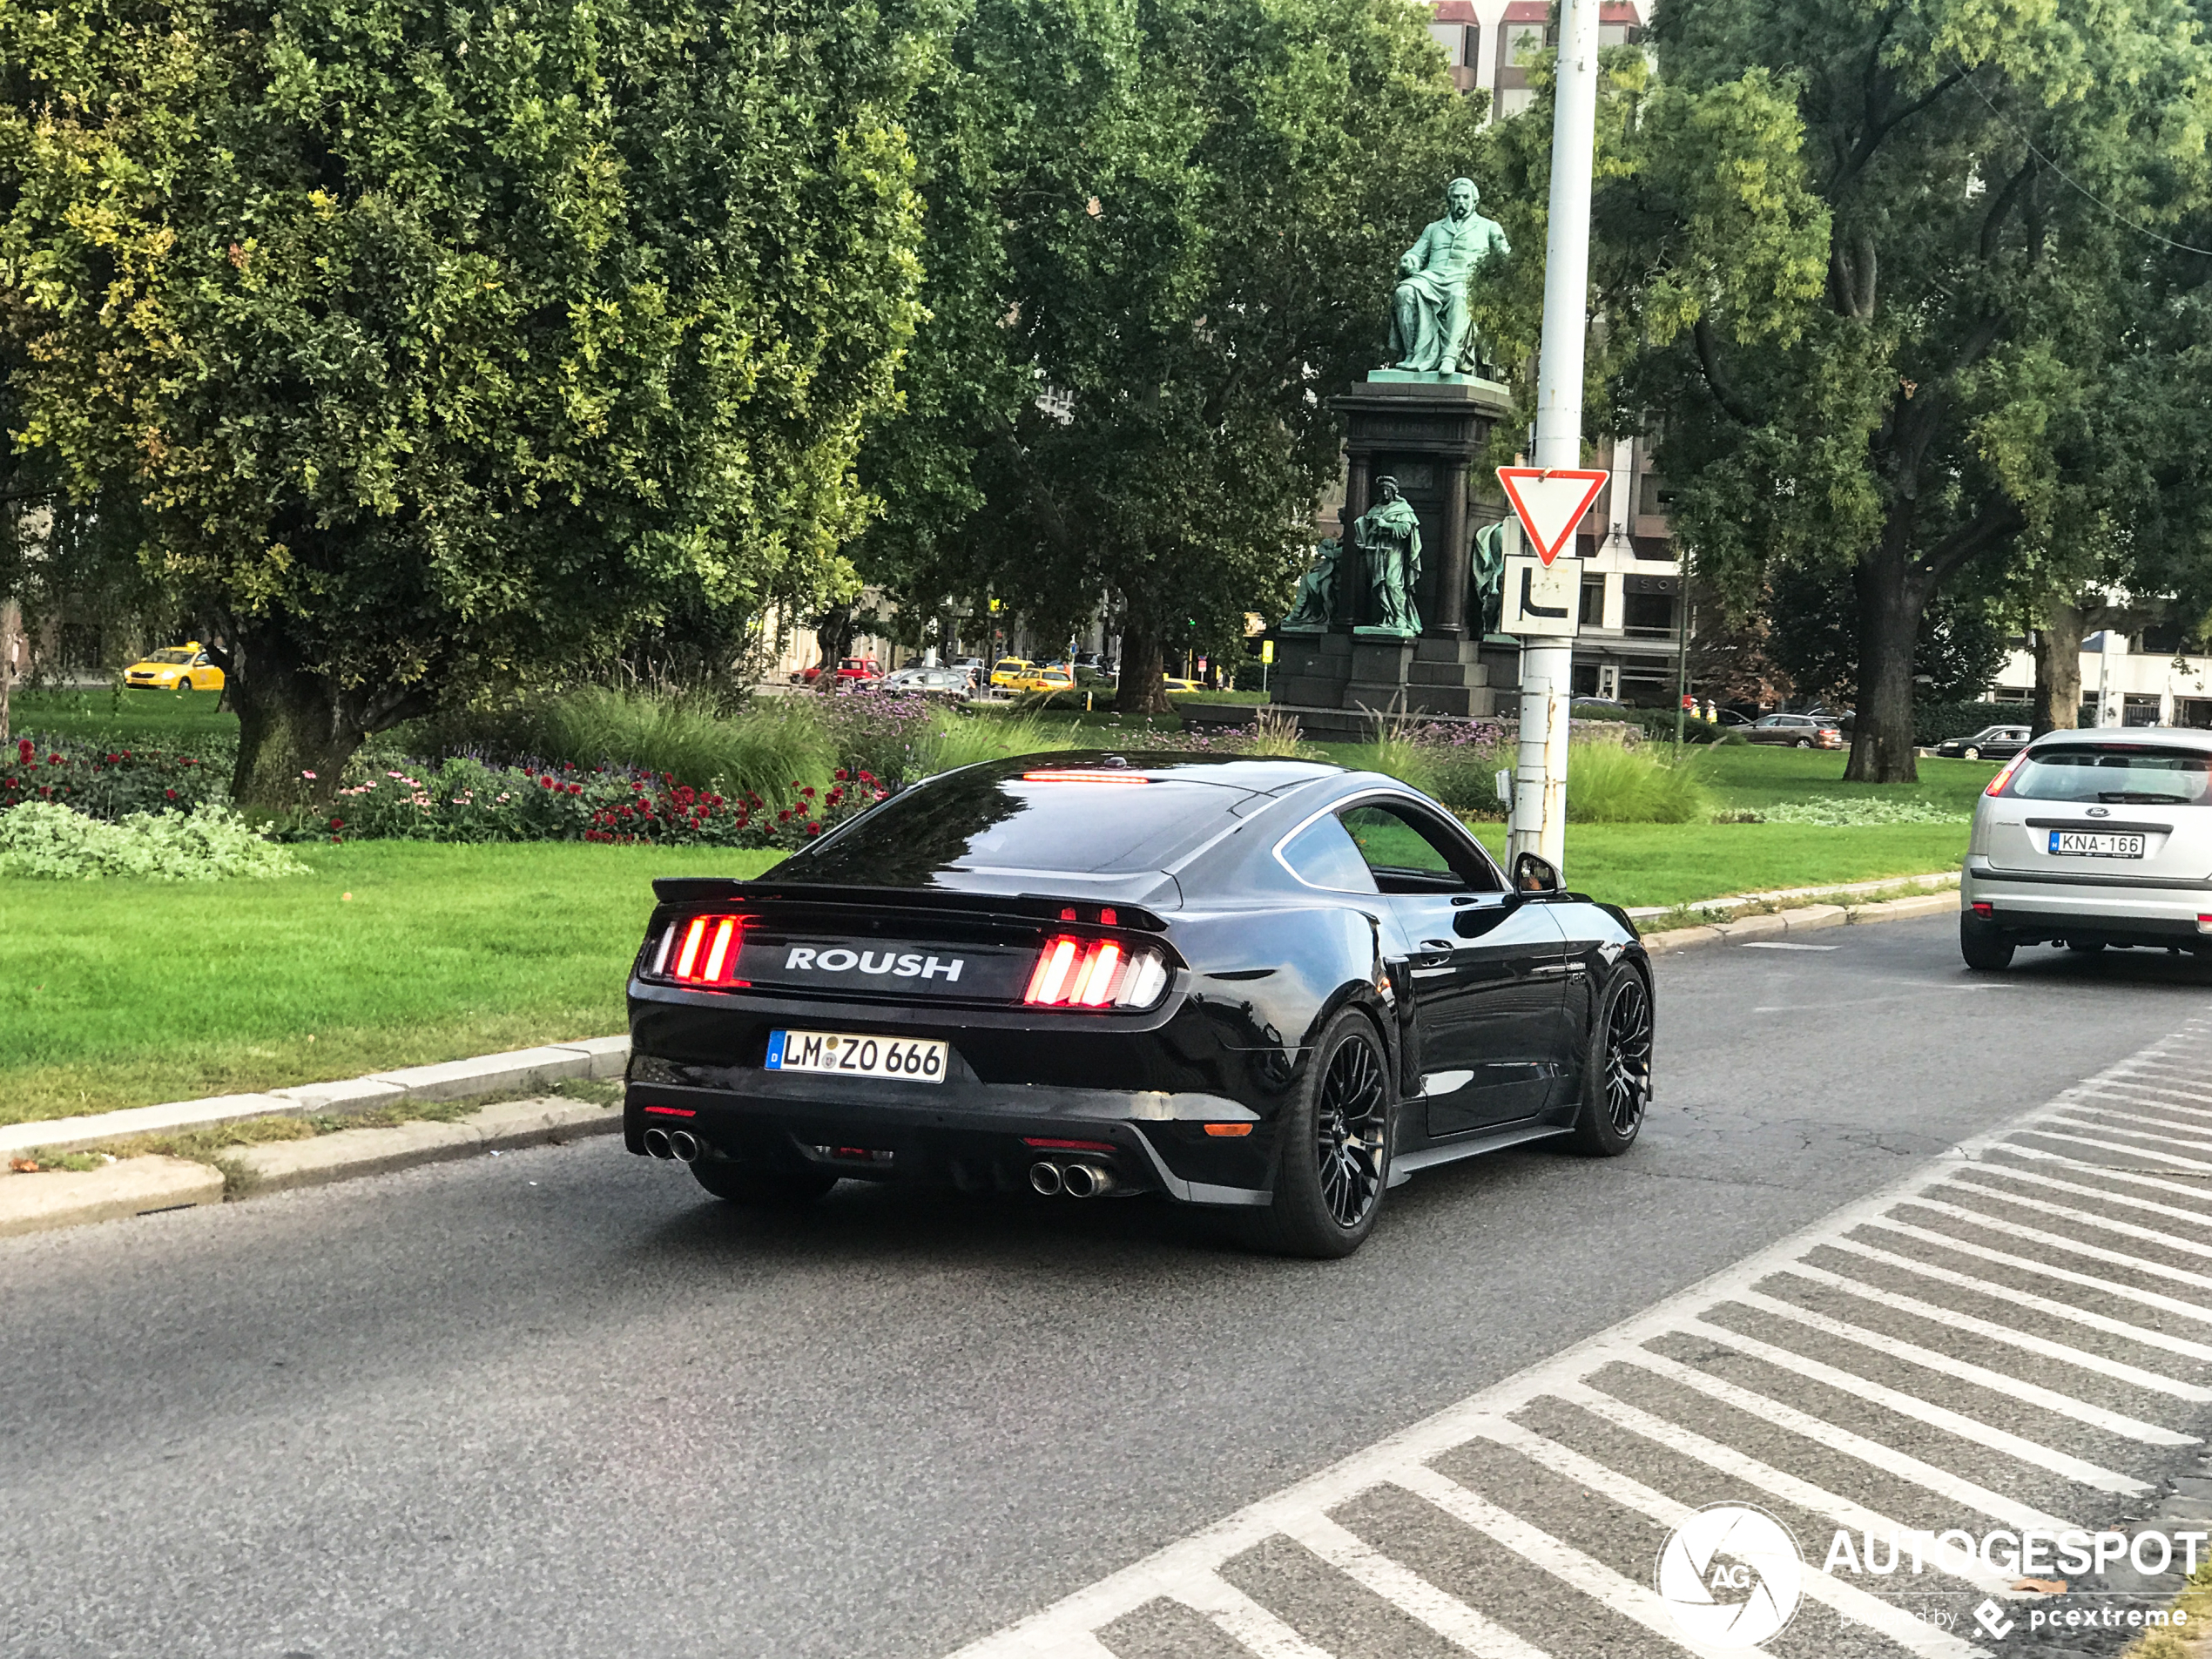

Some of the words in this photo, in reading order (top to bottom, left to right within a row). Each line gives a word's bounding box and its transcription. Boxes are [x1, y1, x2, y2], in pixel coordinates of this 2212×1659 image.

[2062, 834, 2139, 853] KNA-166
[785, 948, 964, 982] ROUSH
[771, 1053, 778, 1062] D
[783, 1035, 822, 1067] LM
[840, 1038, 878, 1071] ZO
[885, 1042, 941, 1076] 666
